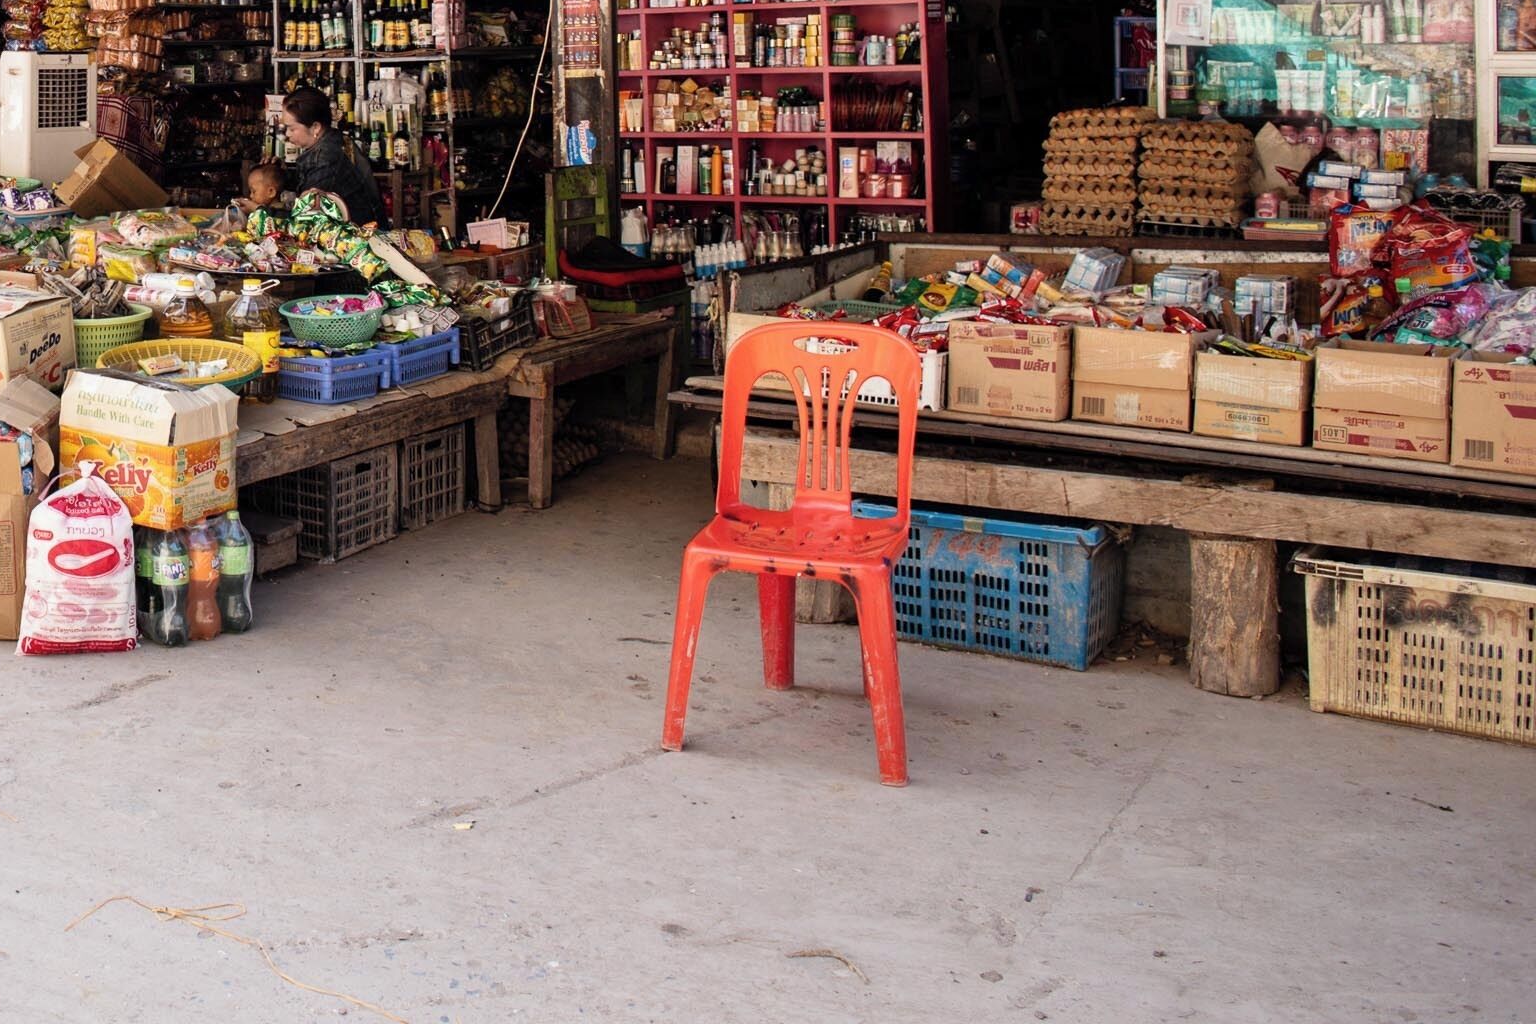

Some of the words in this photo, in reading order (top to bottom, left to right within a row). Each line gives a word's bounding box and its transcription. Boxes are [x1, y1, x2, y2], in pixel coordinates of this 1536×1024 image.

[29, 332, 61, 365] DeeDo
[76, 404, 106, 420] Handle
[109, 410, 130, 424] With
[134, 414, 155, 429] Care
[1322, 427, 1345, 439] LAOS
[192, 458, 219, 477] Kelly
